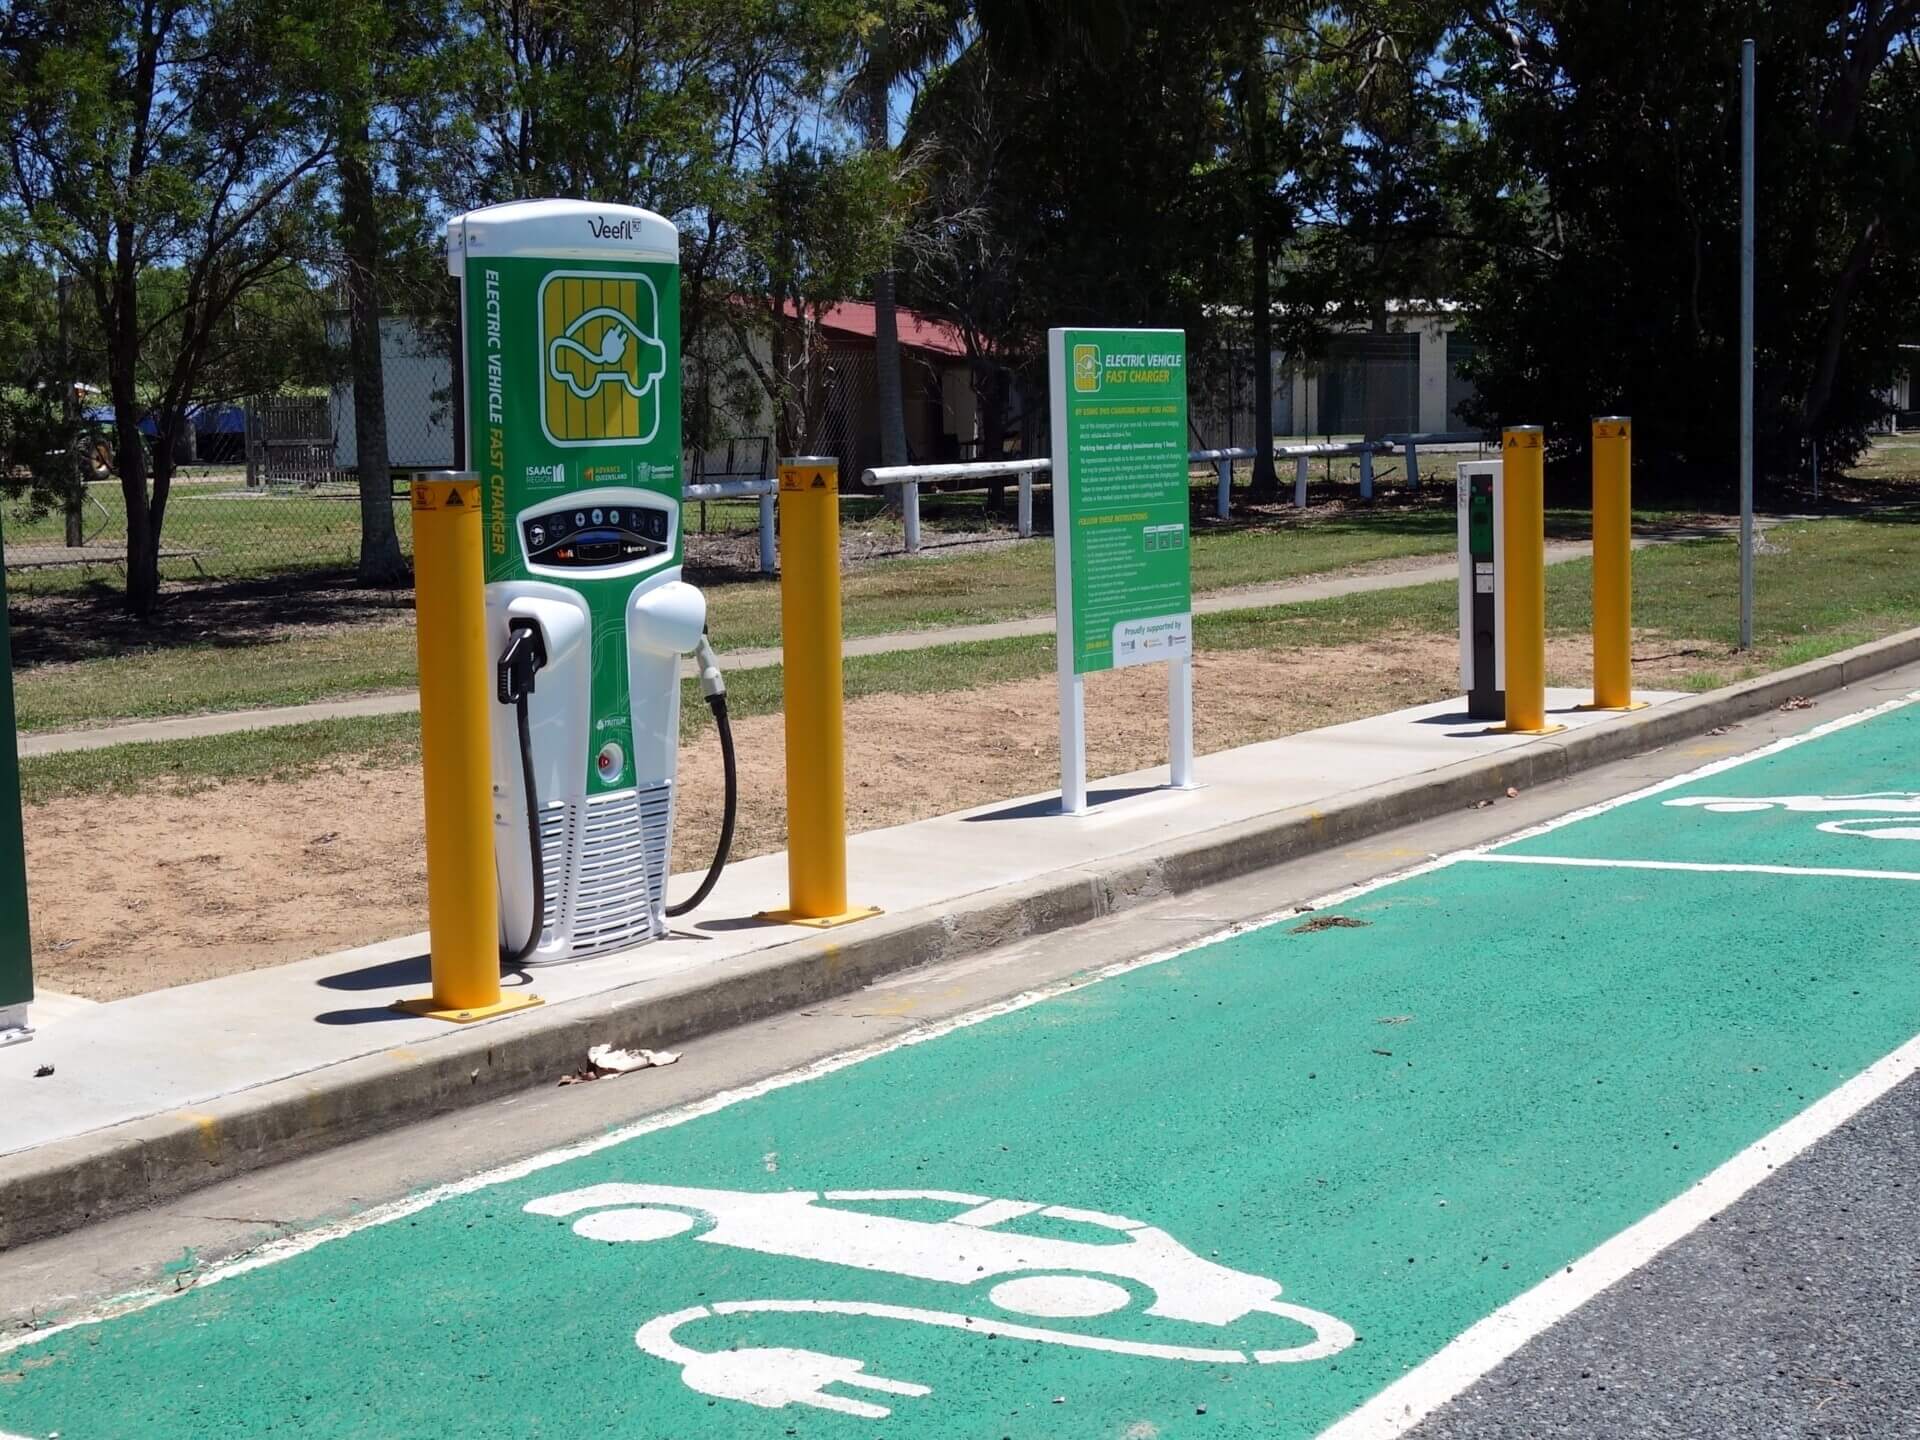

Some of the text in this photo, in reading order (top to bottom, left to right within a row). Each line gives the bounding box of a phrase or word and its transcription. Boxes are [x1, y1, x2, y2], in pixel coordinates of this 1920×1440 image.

[587, 215, 633, 240] Veefil
[1105, 354, 1182, 367] ELECTRIC VEHICLE
[1105, 370, 1170, 383] FAST CHARGER
[485, 268, 505, 555] ELECTRIC VEHICLE FAST CHARGER
[526, 465, 552, 476] ISAAC
[595, 465, 620, 474] ADVANCE
[526, 475, 552, 483] REGION
[595, 473, 628, 481] QUEENSLAND
[1124, 620, 1182, 636] Proudly supported by
